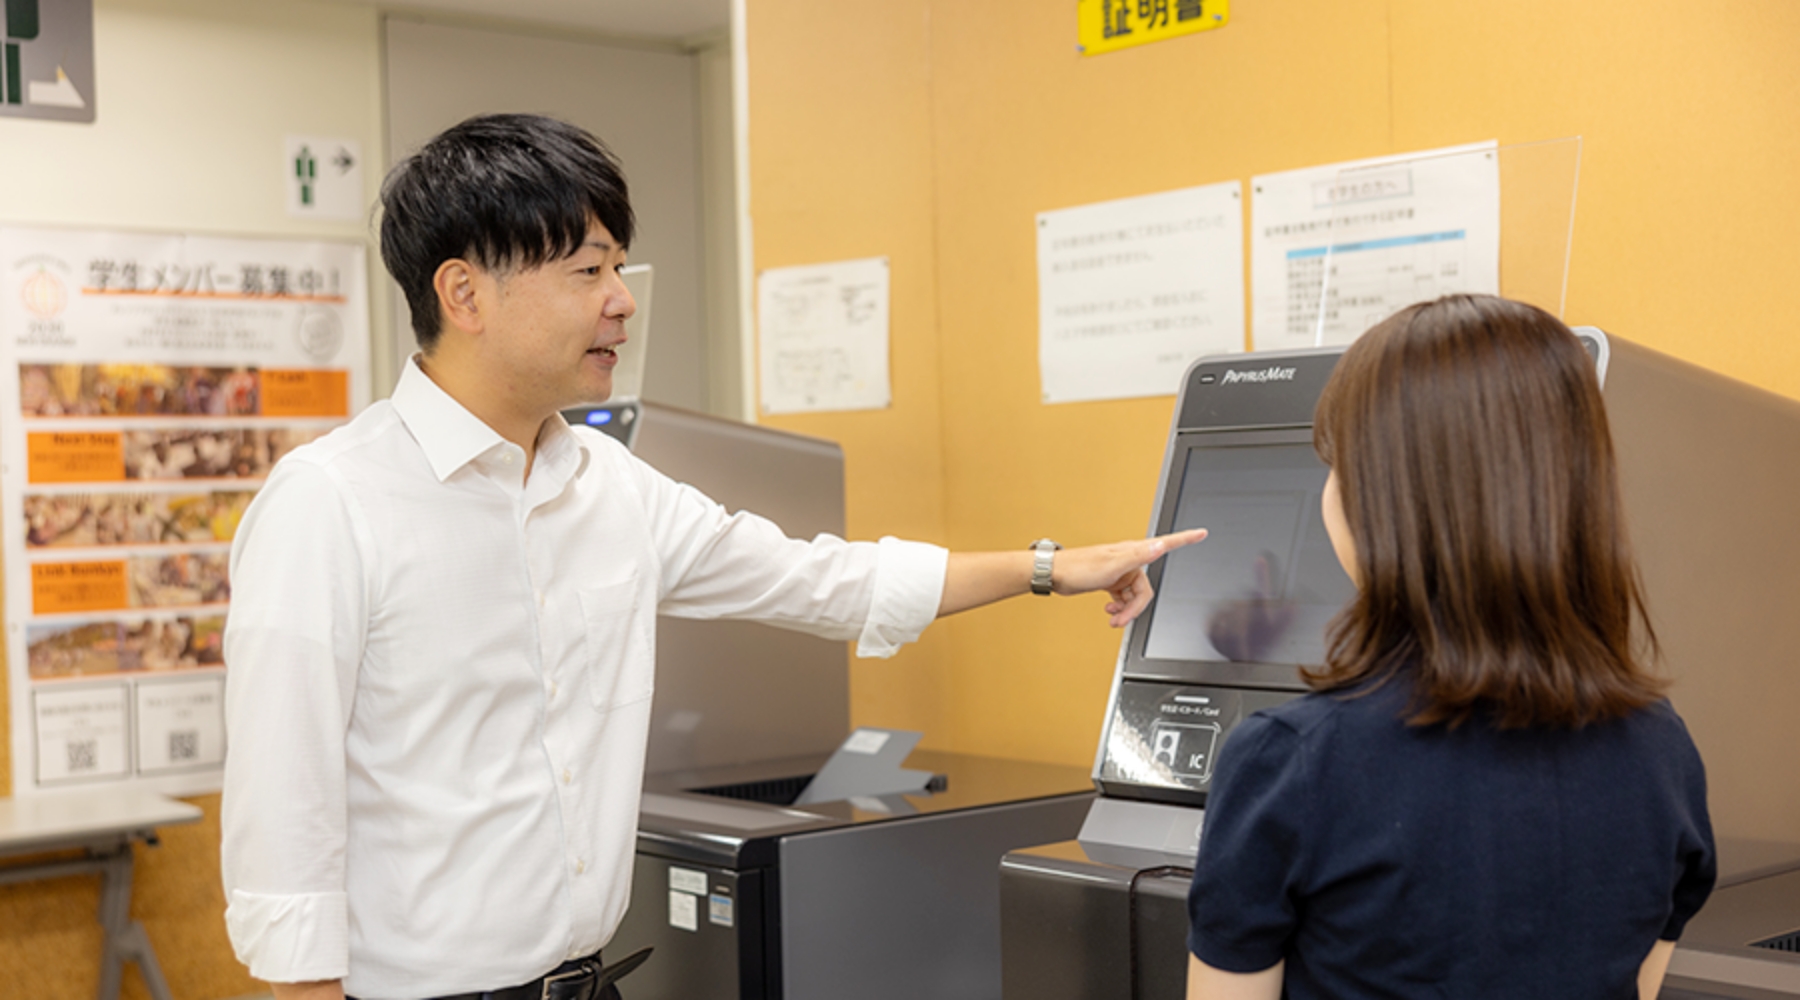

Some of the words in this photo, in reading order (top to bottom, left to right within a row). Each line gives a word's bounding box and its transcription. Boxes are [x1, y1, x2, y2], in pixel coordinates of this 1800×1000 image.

[1102, 0, 1203, 39] 証明書
[1189, 754, 1205, 769] IC
